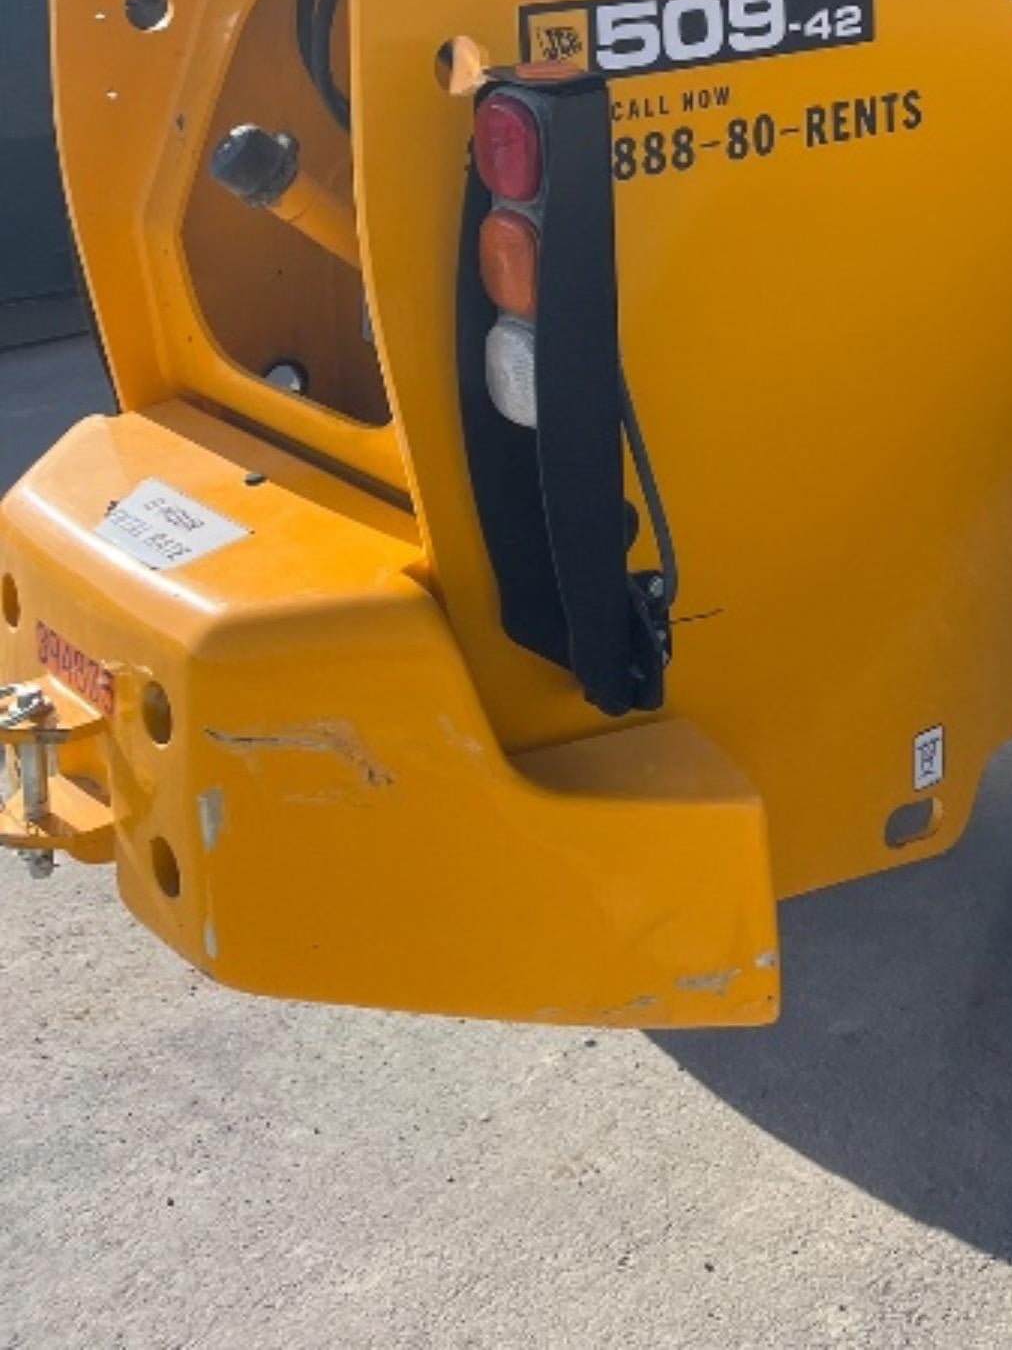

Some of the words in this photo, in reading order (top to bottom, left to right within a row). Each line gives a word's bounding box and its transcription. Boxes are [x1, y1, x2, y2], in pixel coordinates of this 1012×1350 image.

[612, 96, 669, 121] CALL
[683, 86, 731, 112] NOW
[613, 91, 923, 181] 888-80-RENTS
